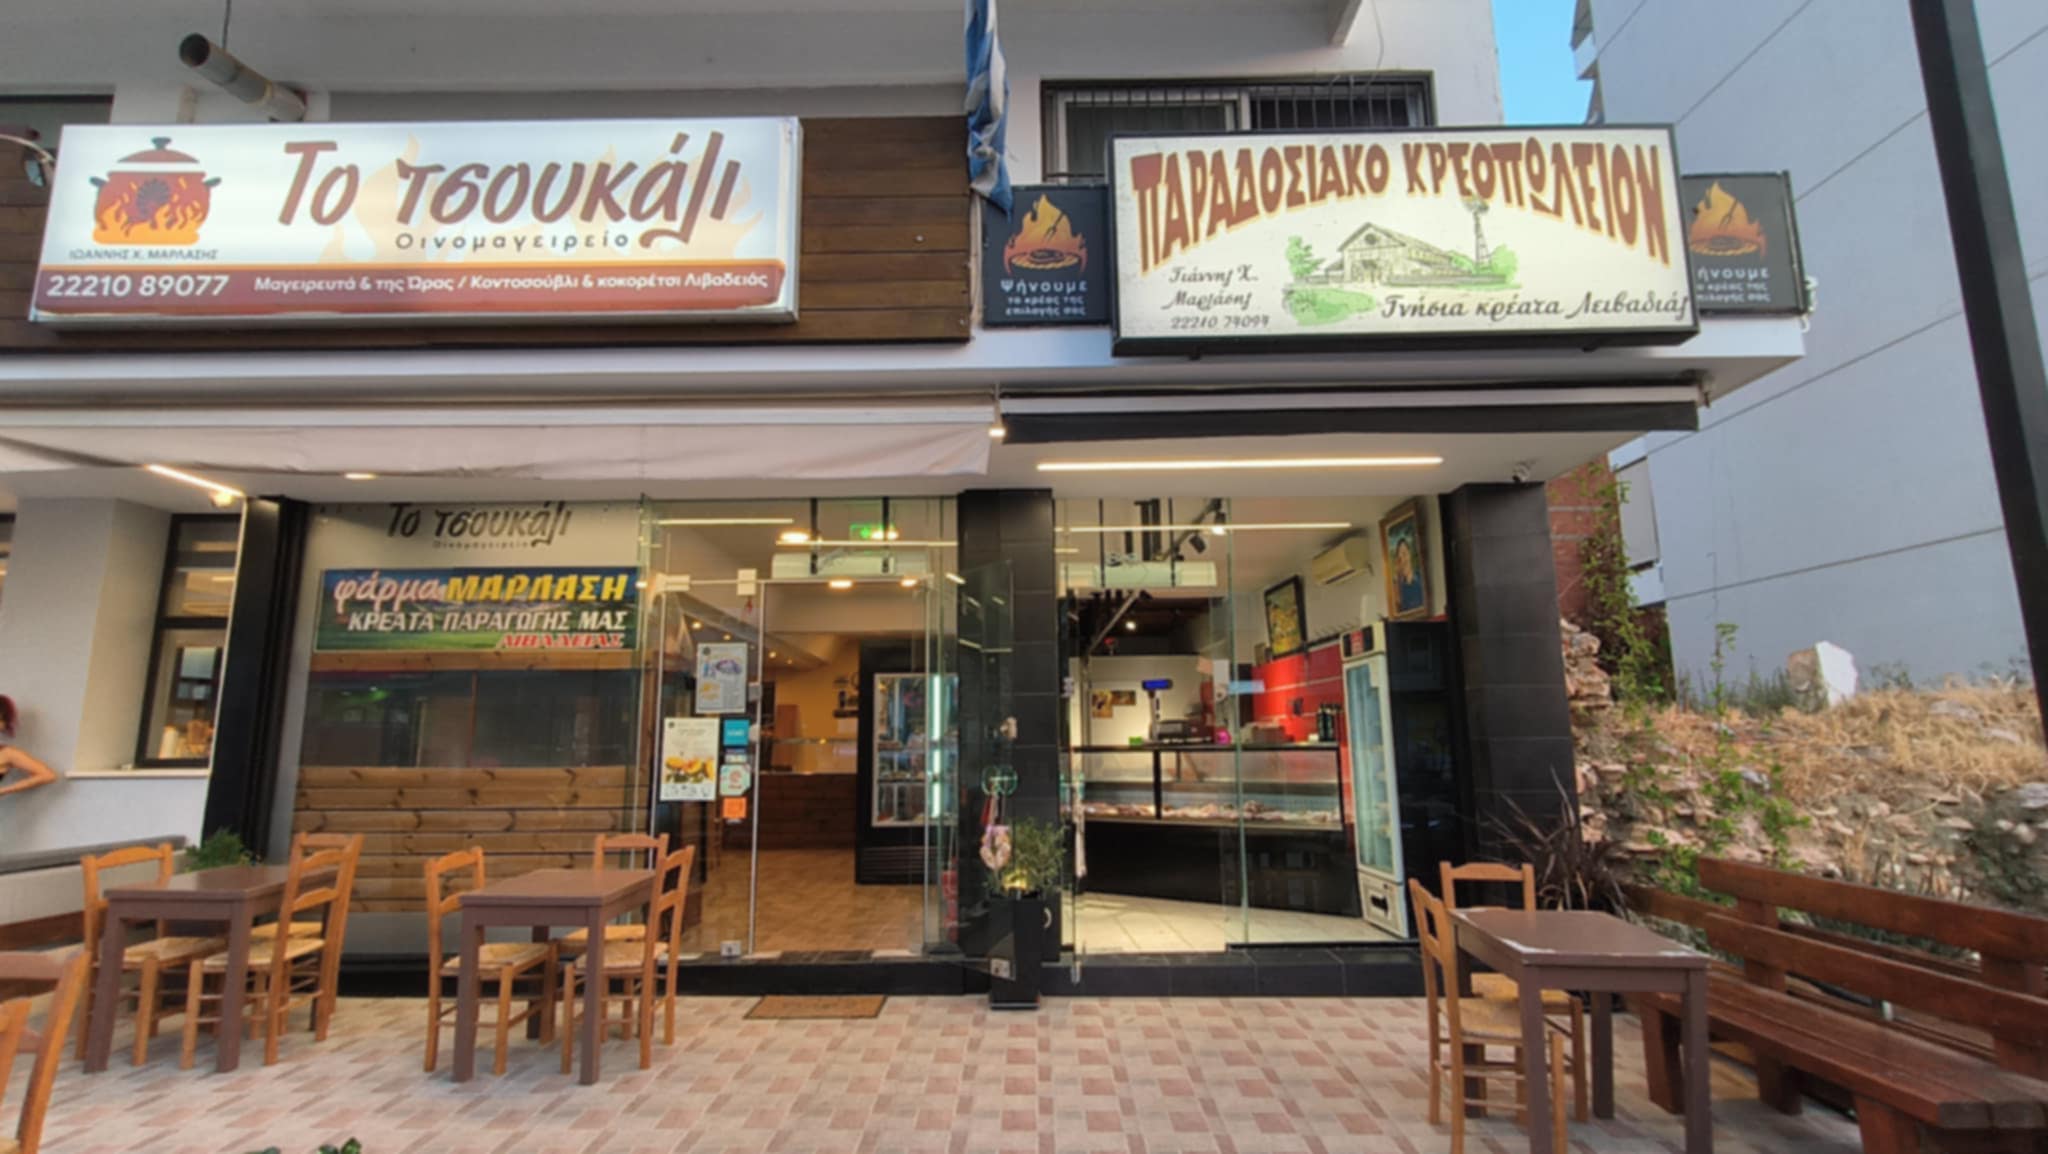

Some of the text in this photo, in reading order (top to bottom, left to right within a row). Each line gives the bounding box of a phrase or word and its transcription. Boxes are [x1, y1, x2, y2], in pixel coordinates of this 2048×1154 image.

[278, 131, 741, 249] Το τσουκάλι
[1130, 136, 1671, 274] ΠΑΡΑΔΟΣΙΑΚΟ ΚΡΕΟΠΩΛΕΙΟΝ
[395, 232, 629, 251] Οινομαγειρείο
[70, 250, 130, 260] ΙΩΑΝΝΗΣ
[148, 249, 218, 260] ΜΑΡΛΑΣΗΣ
[254, 276, 357, 293] Μαγειρευτά
[359, 278, 372, 290] &
[376, 279, 405, 292] της
[470, 274, 578, 291] Κοντοσούβλι
[582, 275, 594, 288] &
[597, 274, 682, 289] κοκορέτσι
[684, 273, 769, 290] Λιβαδειάς
[1697, 266, 1770, 282] ήνουμε
[47, 274, 230, 297] 22210 89077
[1381, 295, 1467, 318] Γνήσια
[1475, 294, 1561, 321] κρέατα
[1170, 315, 1219, 330] 22210
[387, 503, 420, 537] Το
[334, 571, 628, 614] φάρμα ΜΑΡΛΑΣΗ
[348, 610, 627, 631] ΚΡΕΑΤΑ ΠΑΡΑΓΩΓΗΣ ΜΑΣ
